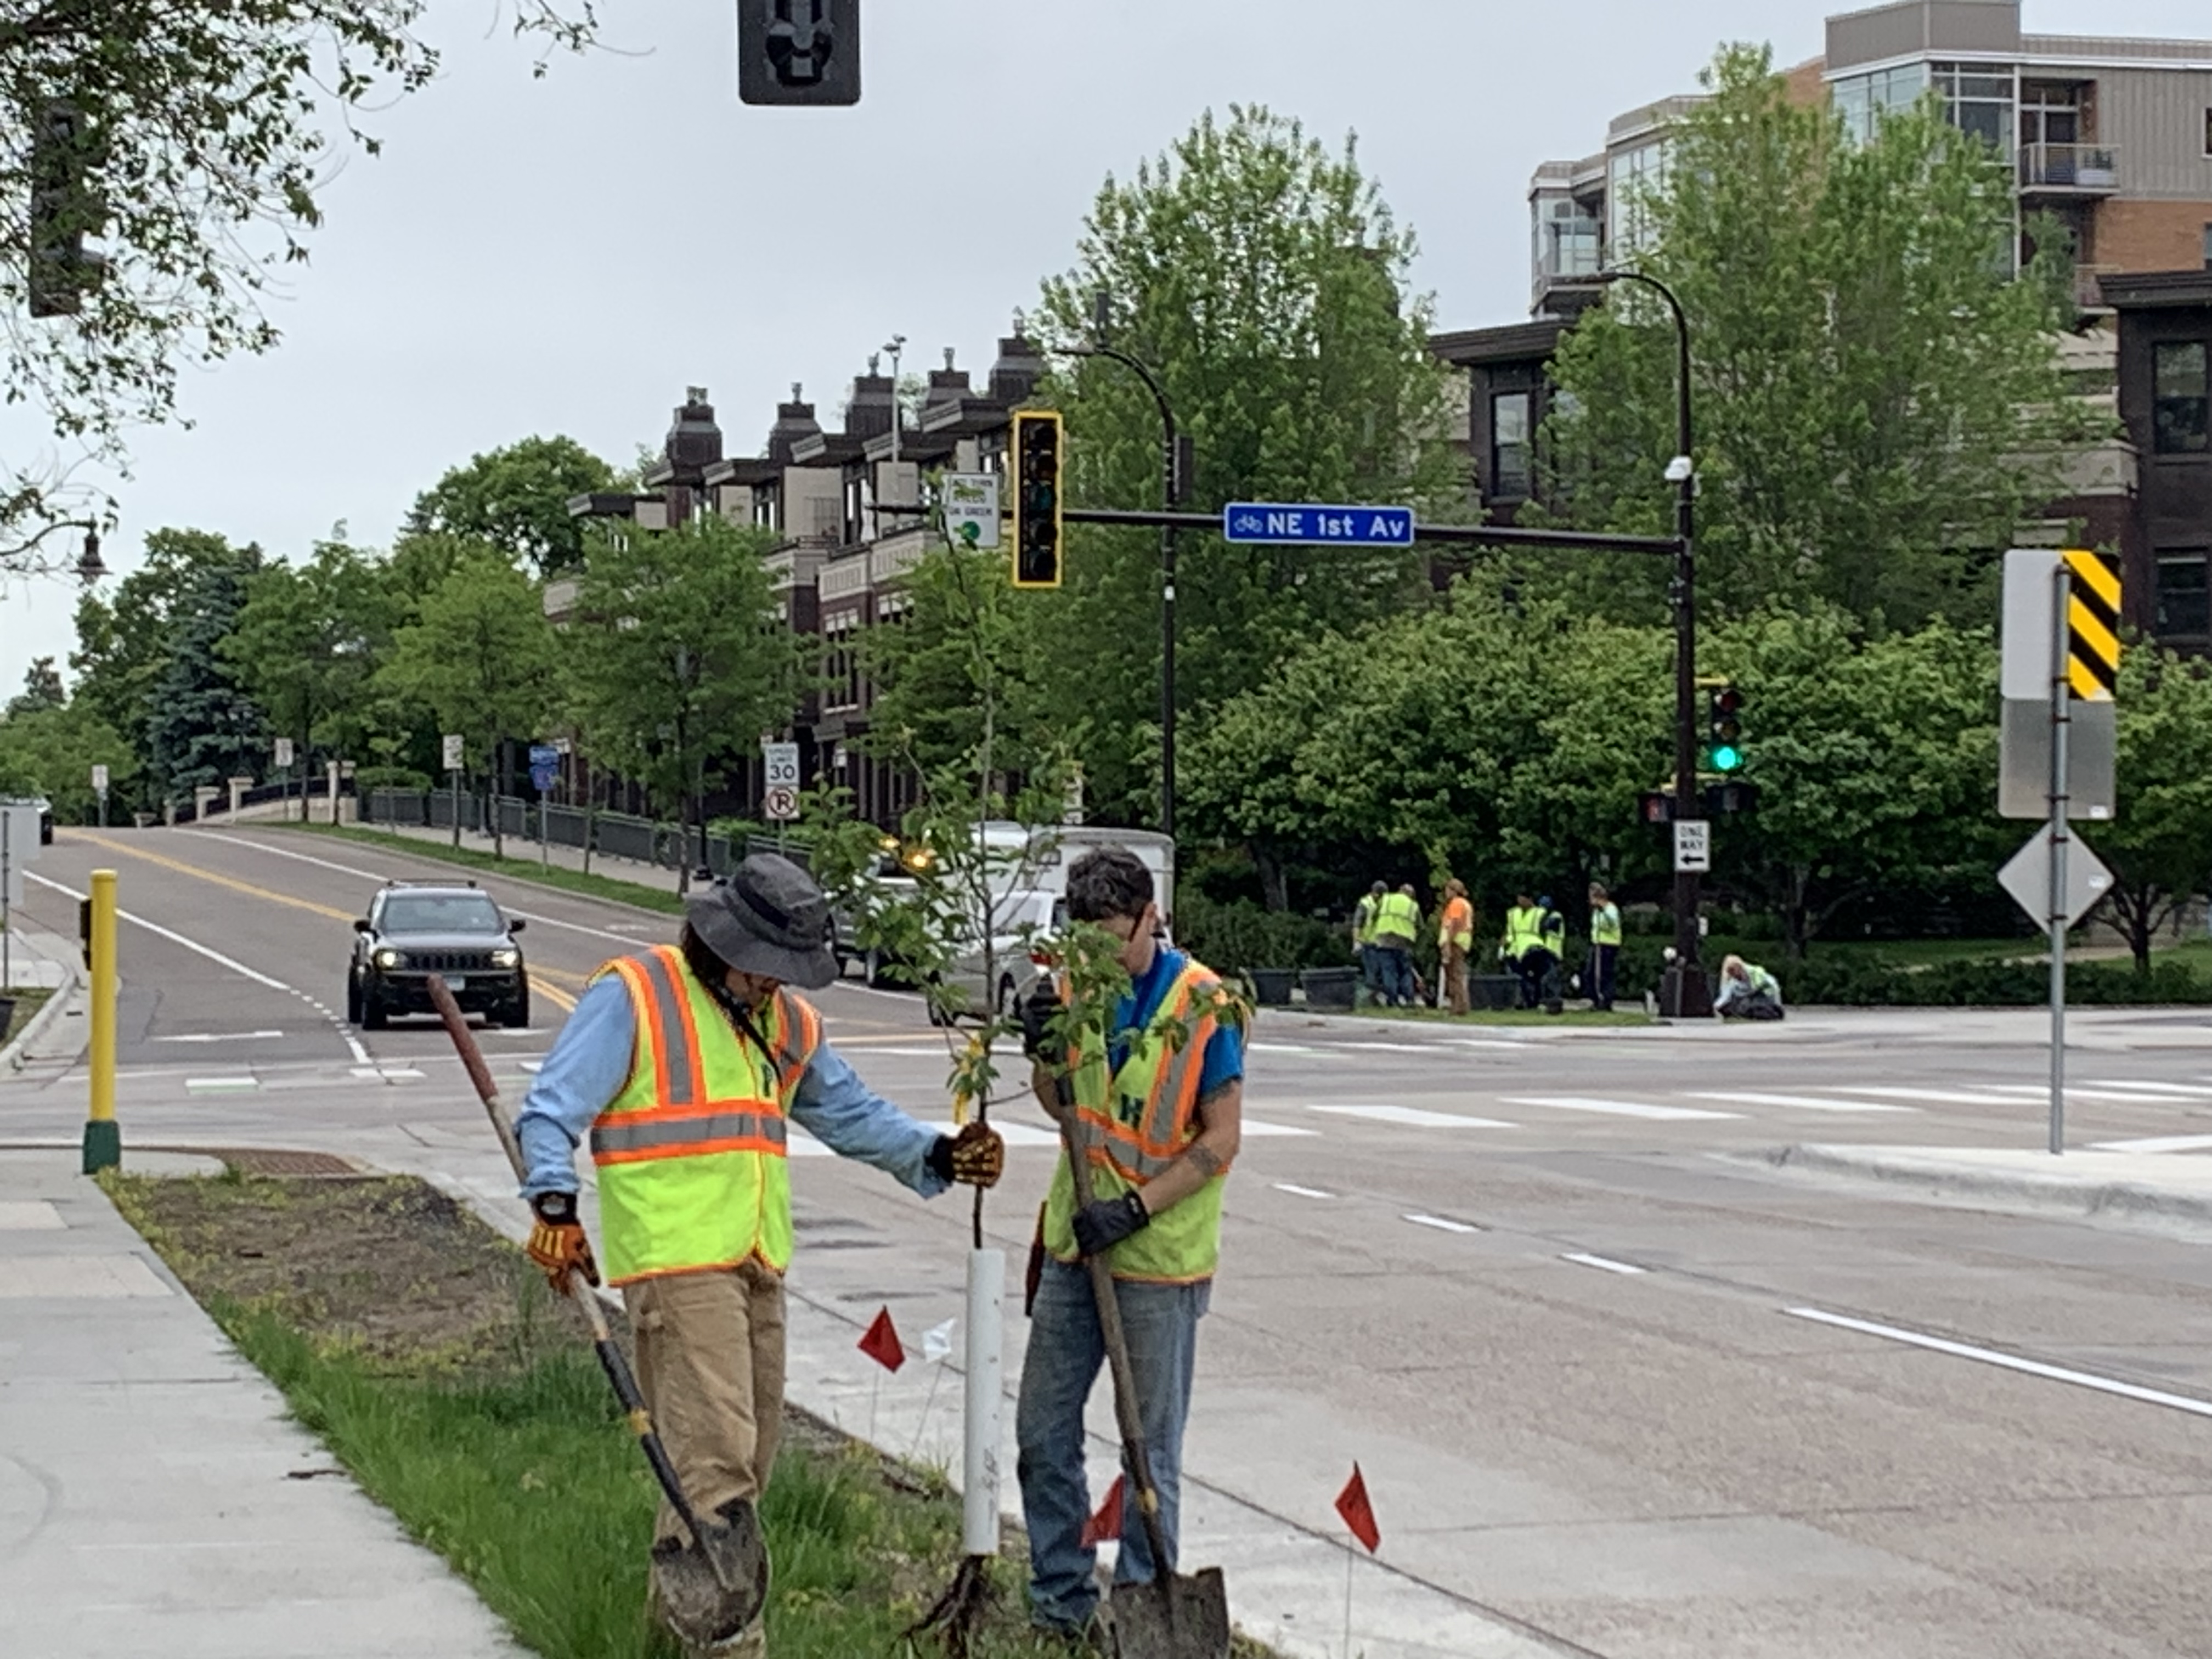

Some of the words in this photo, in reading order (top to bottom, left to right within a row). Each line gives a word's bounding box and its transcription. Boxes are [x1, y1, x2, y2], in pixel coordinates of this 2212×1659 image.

[1267, 513, 1303, 536] NE
[1317, 514, 1353, 537] 1st
[1369, 515, 1405, 538] Av
[770, 764, 795, 780] 30
[1680, 839, 1703, 850] WAY
